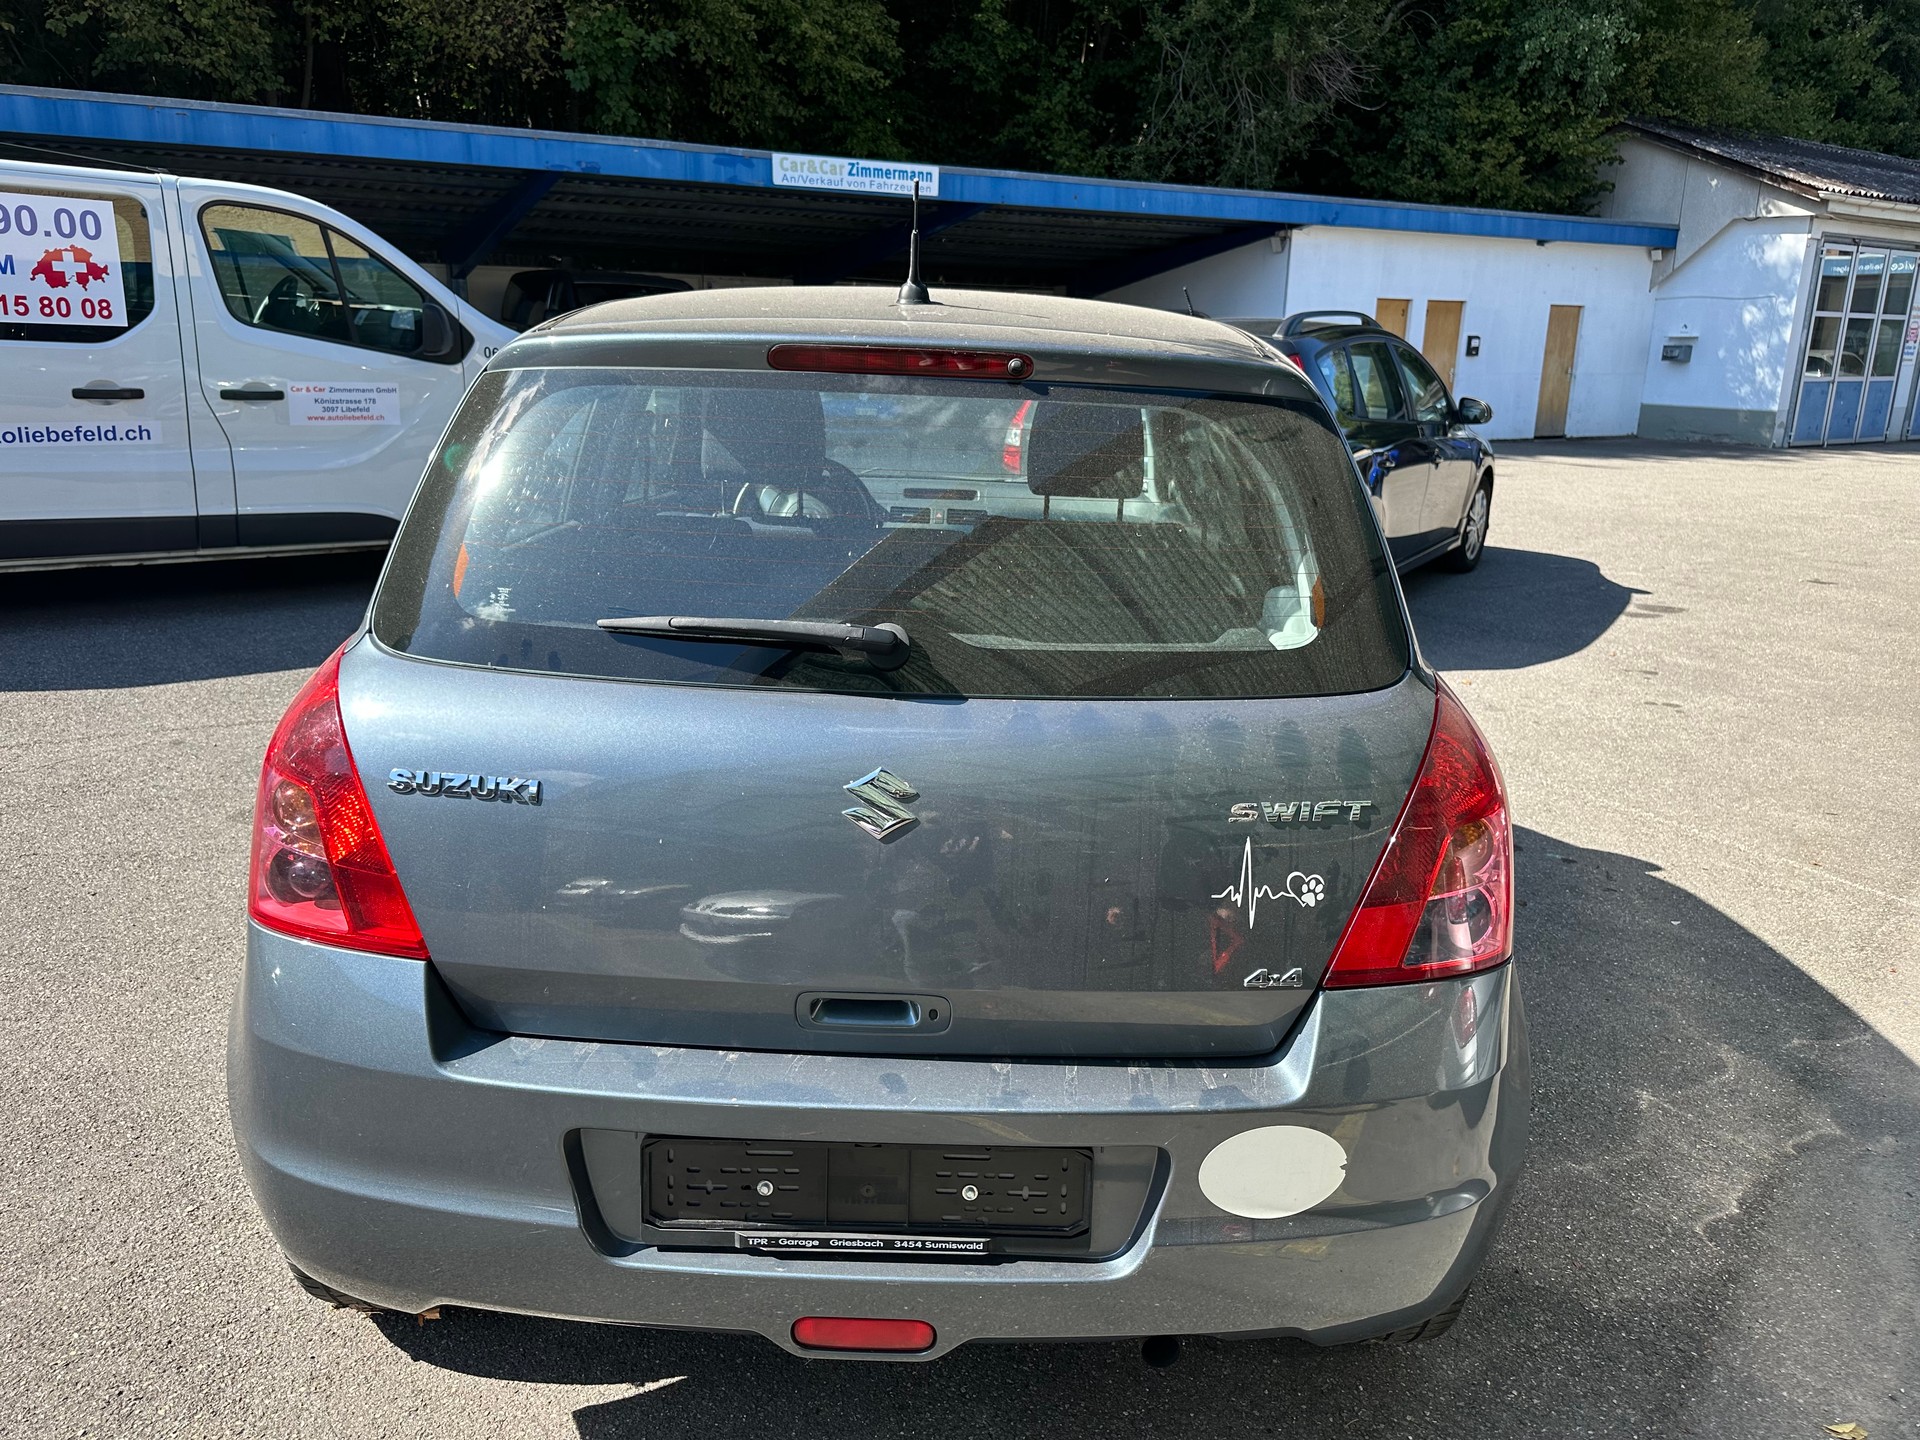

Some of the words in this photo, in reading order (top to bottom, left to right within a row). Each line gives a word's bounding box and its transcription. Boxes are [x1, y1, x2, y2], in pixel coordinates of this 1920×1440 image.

[779, 156, 845, 176] Car&Car
[847, 162, 933, 183] Zimmermann
[781, 173, 844, 187] An/Verkauf
[846, 180, 866, 189] von
[869, 181, 932, 194] Fahrzeuen
[39, 296, 71, 318] 80
[81, 297, 113, 320] 08
[328, 386, 375, 394] Zimmermann
[0, 425, 151, 444] oliebefeld.ch
[387, 768, 543, 806] SUZUKI
[1228, 800, 1372, 823] SWIFT
[1243, 967, 1303, 989] 4x4
[747, 1237, 769, 1246] TPR
[778, 1238, 820, 1248] Garage
[829, 1238, 884, 1248] Griesbach
[893, 1240, 922, 1249] 3454
[924, 1240, 983, 1250] Sumiswald
